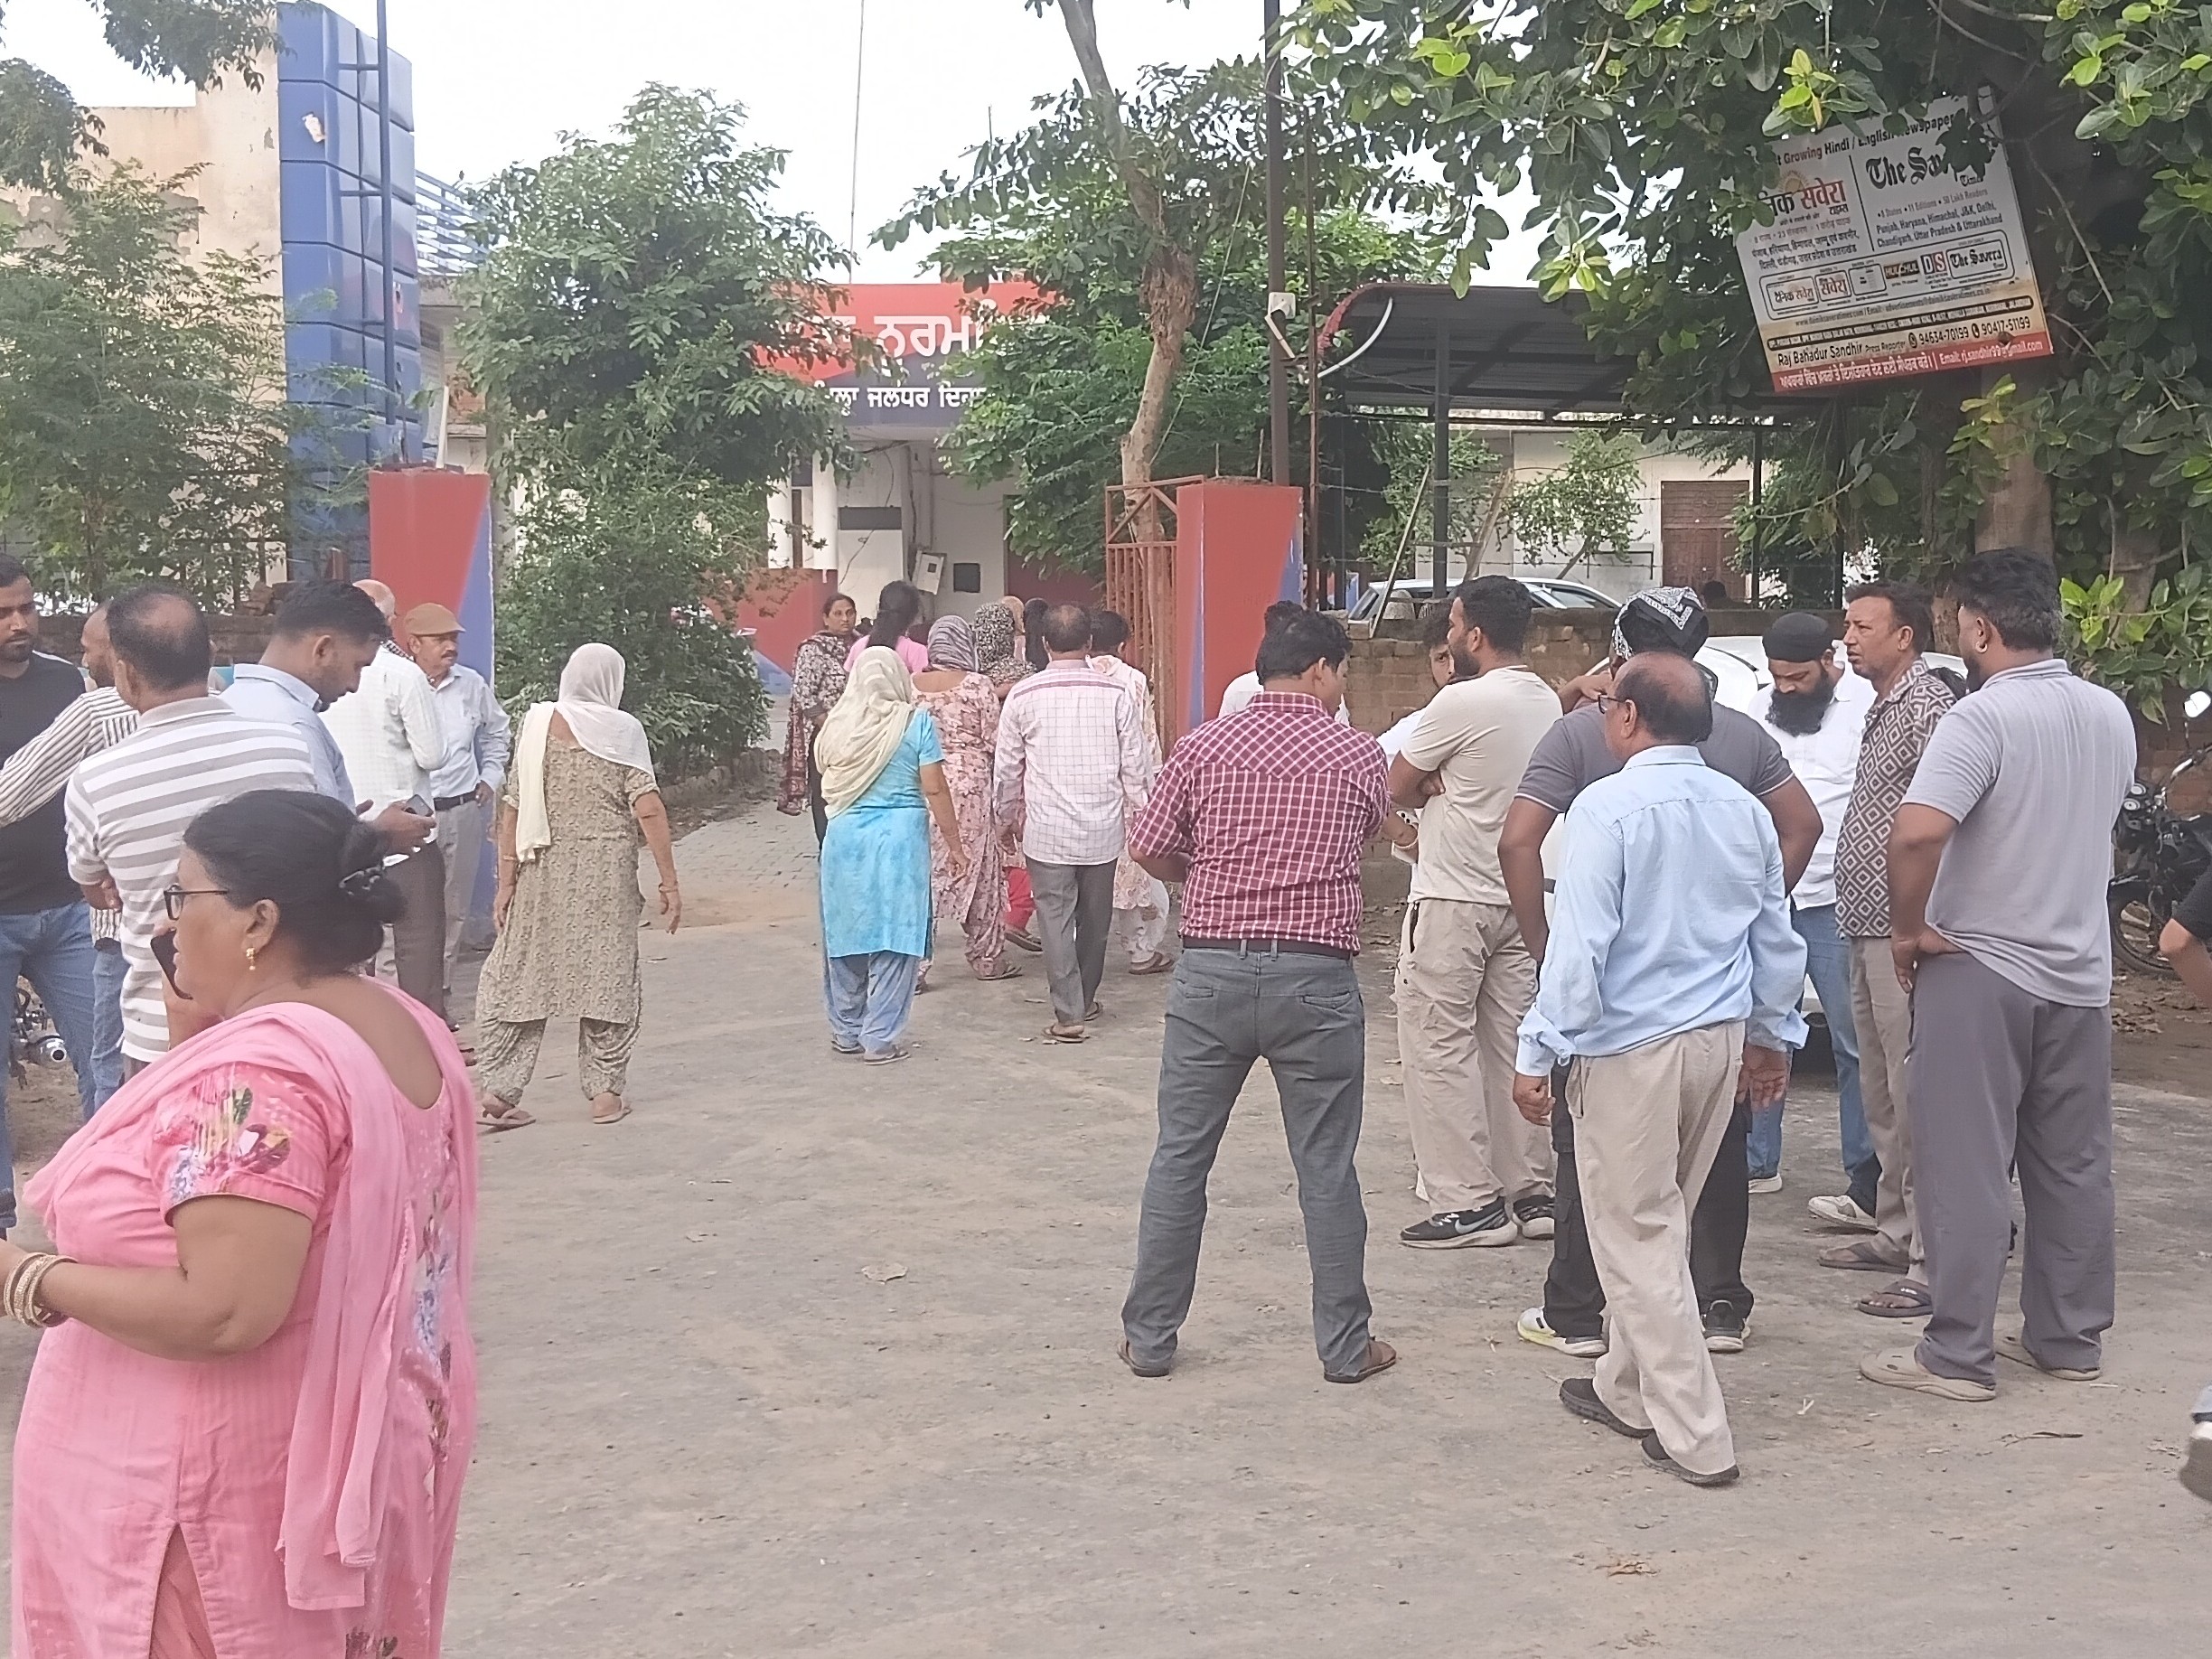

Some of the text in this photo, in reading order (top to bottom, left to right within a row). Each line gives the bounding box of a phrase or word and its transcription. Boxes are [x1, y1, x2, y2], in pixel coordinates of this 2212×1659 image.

[1784, 146, 1823, 164] Growing
[1824, 136, 1850, 155] Hindi
[1851, 136, 1856, 150] /
[1866, 155, 1908, 189] The
[1800, 177, 1847, 210] सवेरा
[1828, 203, 1849, 215] टाइम्स
[1777, 353, 1792, 368] Raj
[1793, 347, 1828, 364] Bahadur
[1830, 342, 1863, 359] Sandhir
[1918, 325, 1969, 345] 94634-70199
[1981, 315, 2031, 335] 90417-51199
